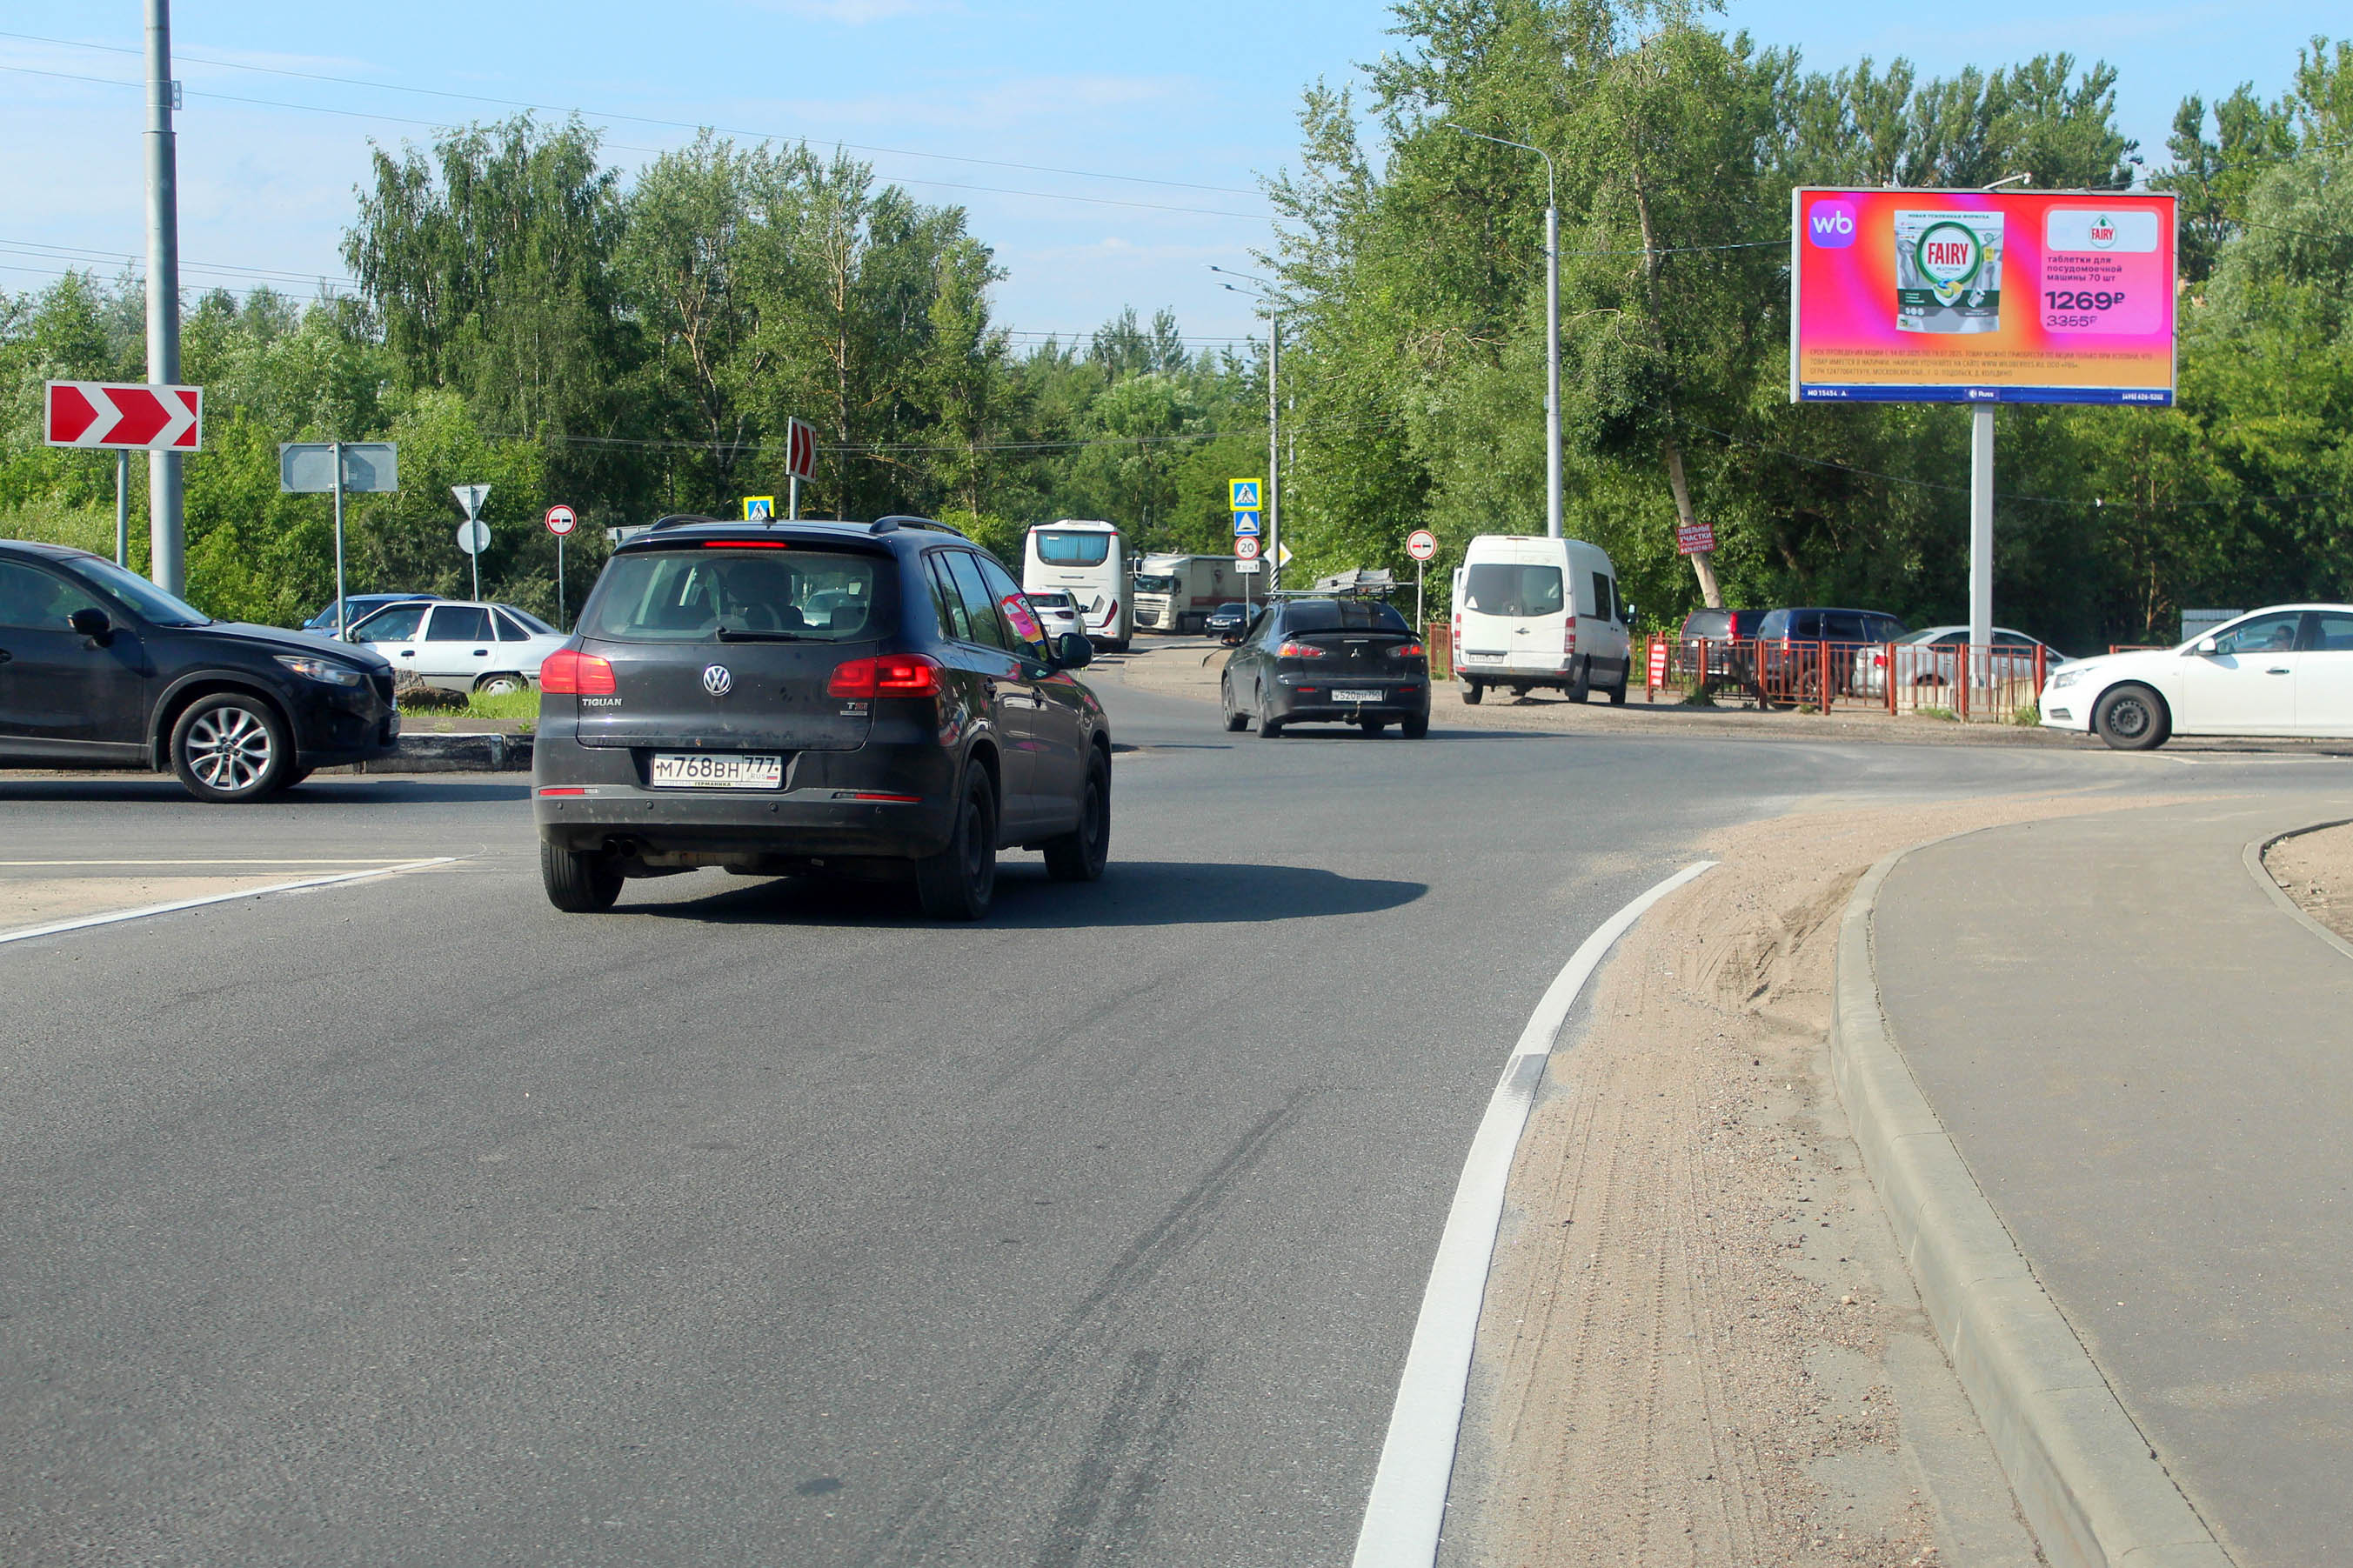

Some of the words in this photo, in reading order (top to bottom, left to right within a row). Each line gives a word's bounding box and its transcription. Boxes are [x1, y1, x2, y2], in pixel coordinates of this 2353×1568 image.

[1812, 210, 1853, 234] wb
[2091, 228, 2114, 240] FAIRY
[1928, 243, 1969, 264] FAIRY
[2048, 255, 2091, 264] таблетки
[2047, 264, 2122, 274] посудомоечной
[1680, 532, 1712, 544] УЧАСТКИ
[1240, 543, 1254, 553] 20
[582, 698, 623, 707] TIGUAN
[659, 757, 739, 777] М768ВН
[744, 757, 776, 773] 777
